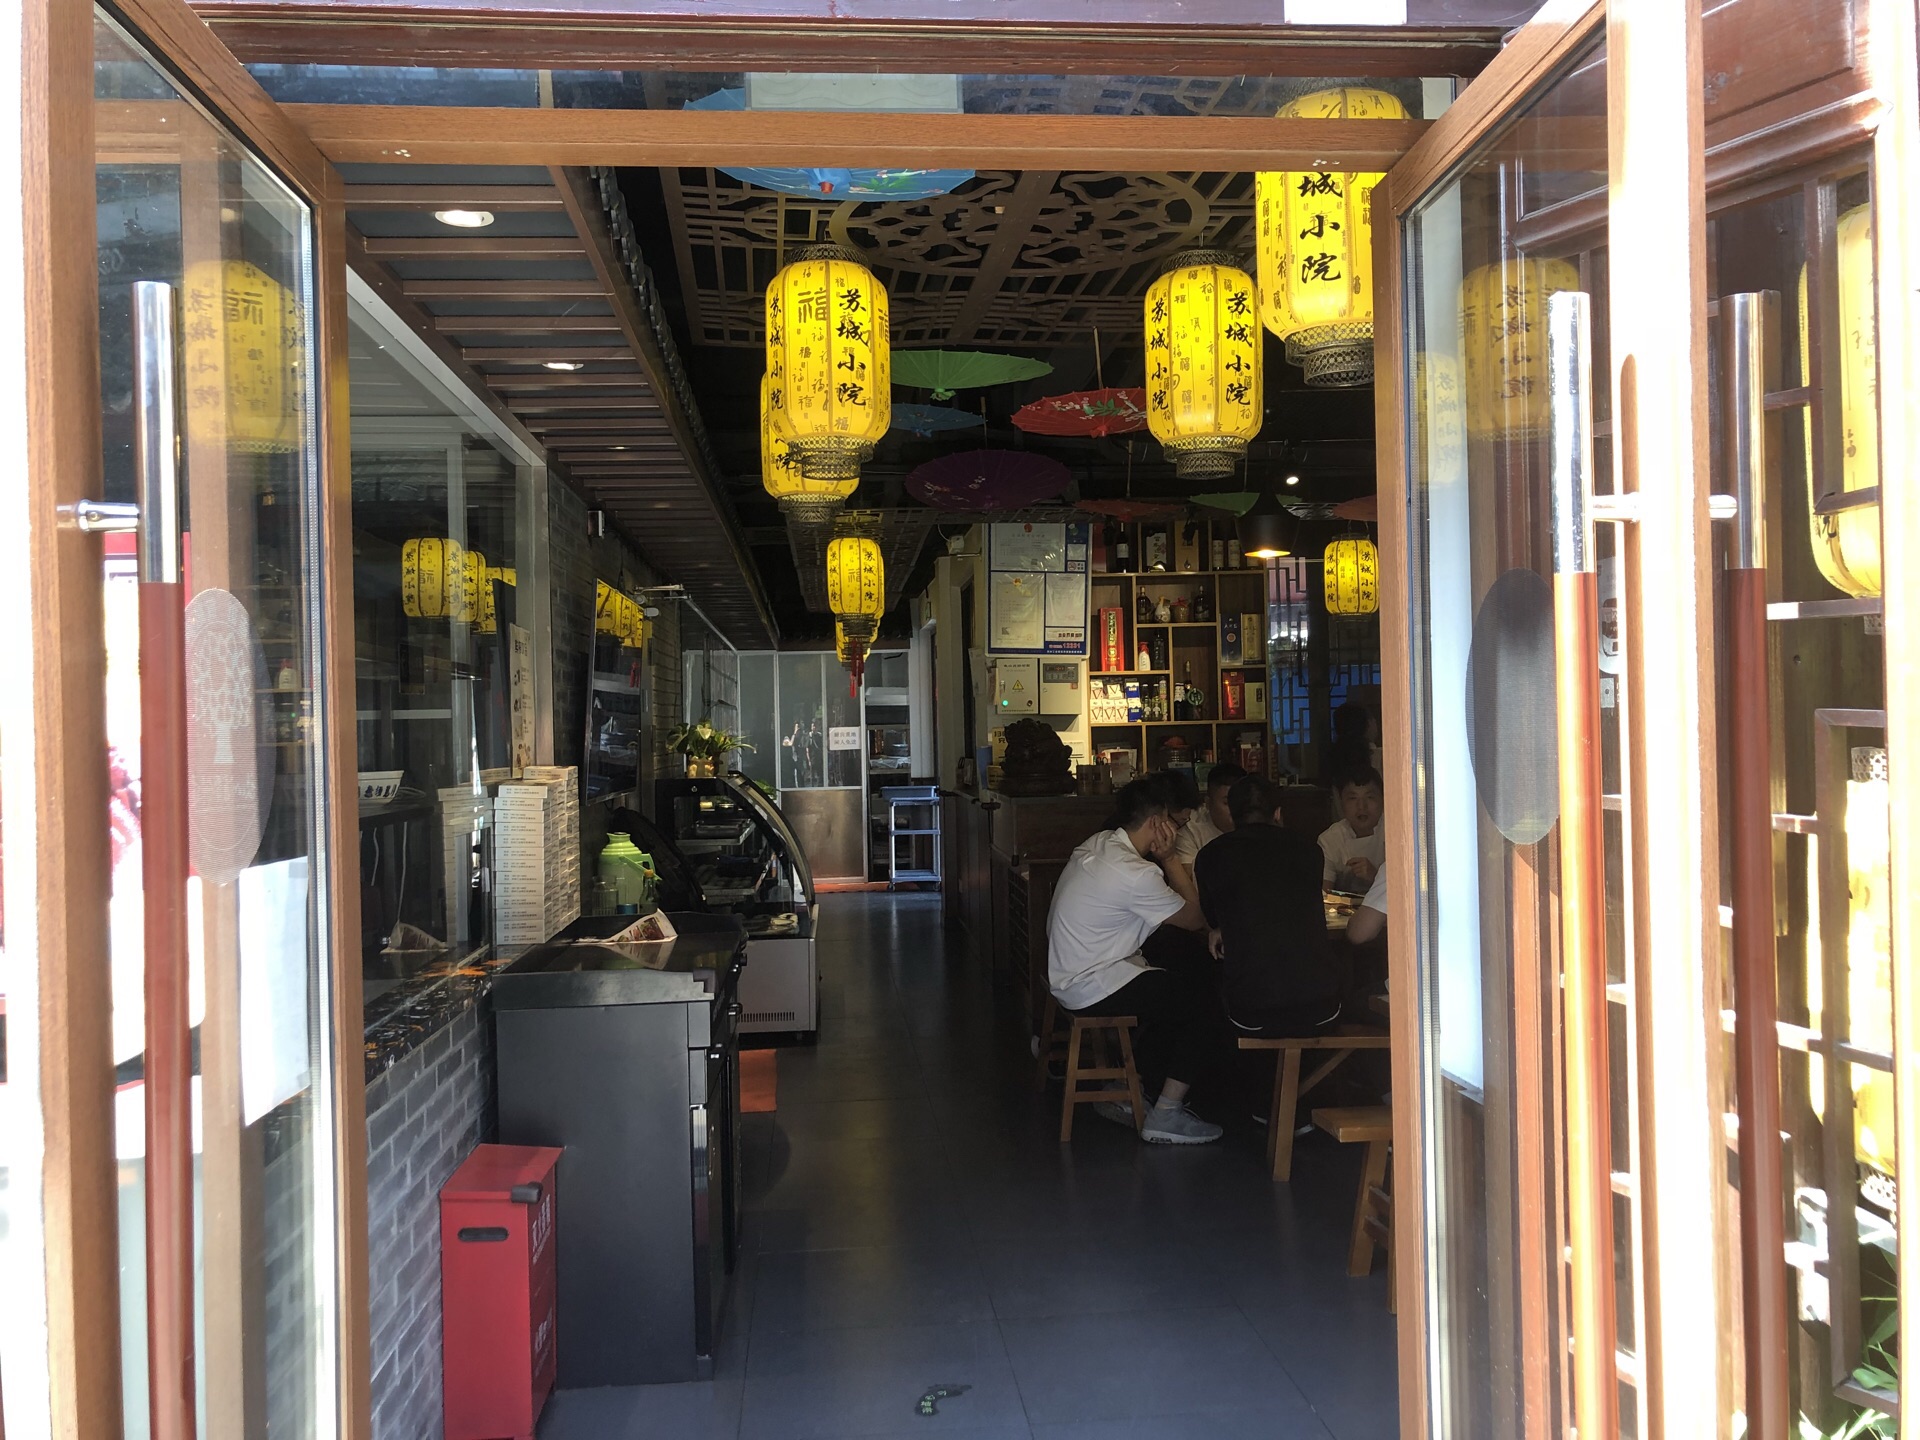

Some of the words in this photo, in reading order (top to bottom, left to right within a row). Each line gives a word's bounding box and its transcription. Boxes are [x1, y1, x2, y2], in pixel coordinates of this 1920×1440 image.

[769, 294, 784, 410] 苏城小院
[798, 287, 827, 323] 福
[836, 288, 869, 406] 苏城小院
[1151, 298, 1169, 412] 苏城小院
[1225, 291, 1253, 405] 苏城小院
[863, 551, 876, 602] 苏城小院
[1361, 551, 1374, 601] 苏城小院
